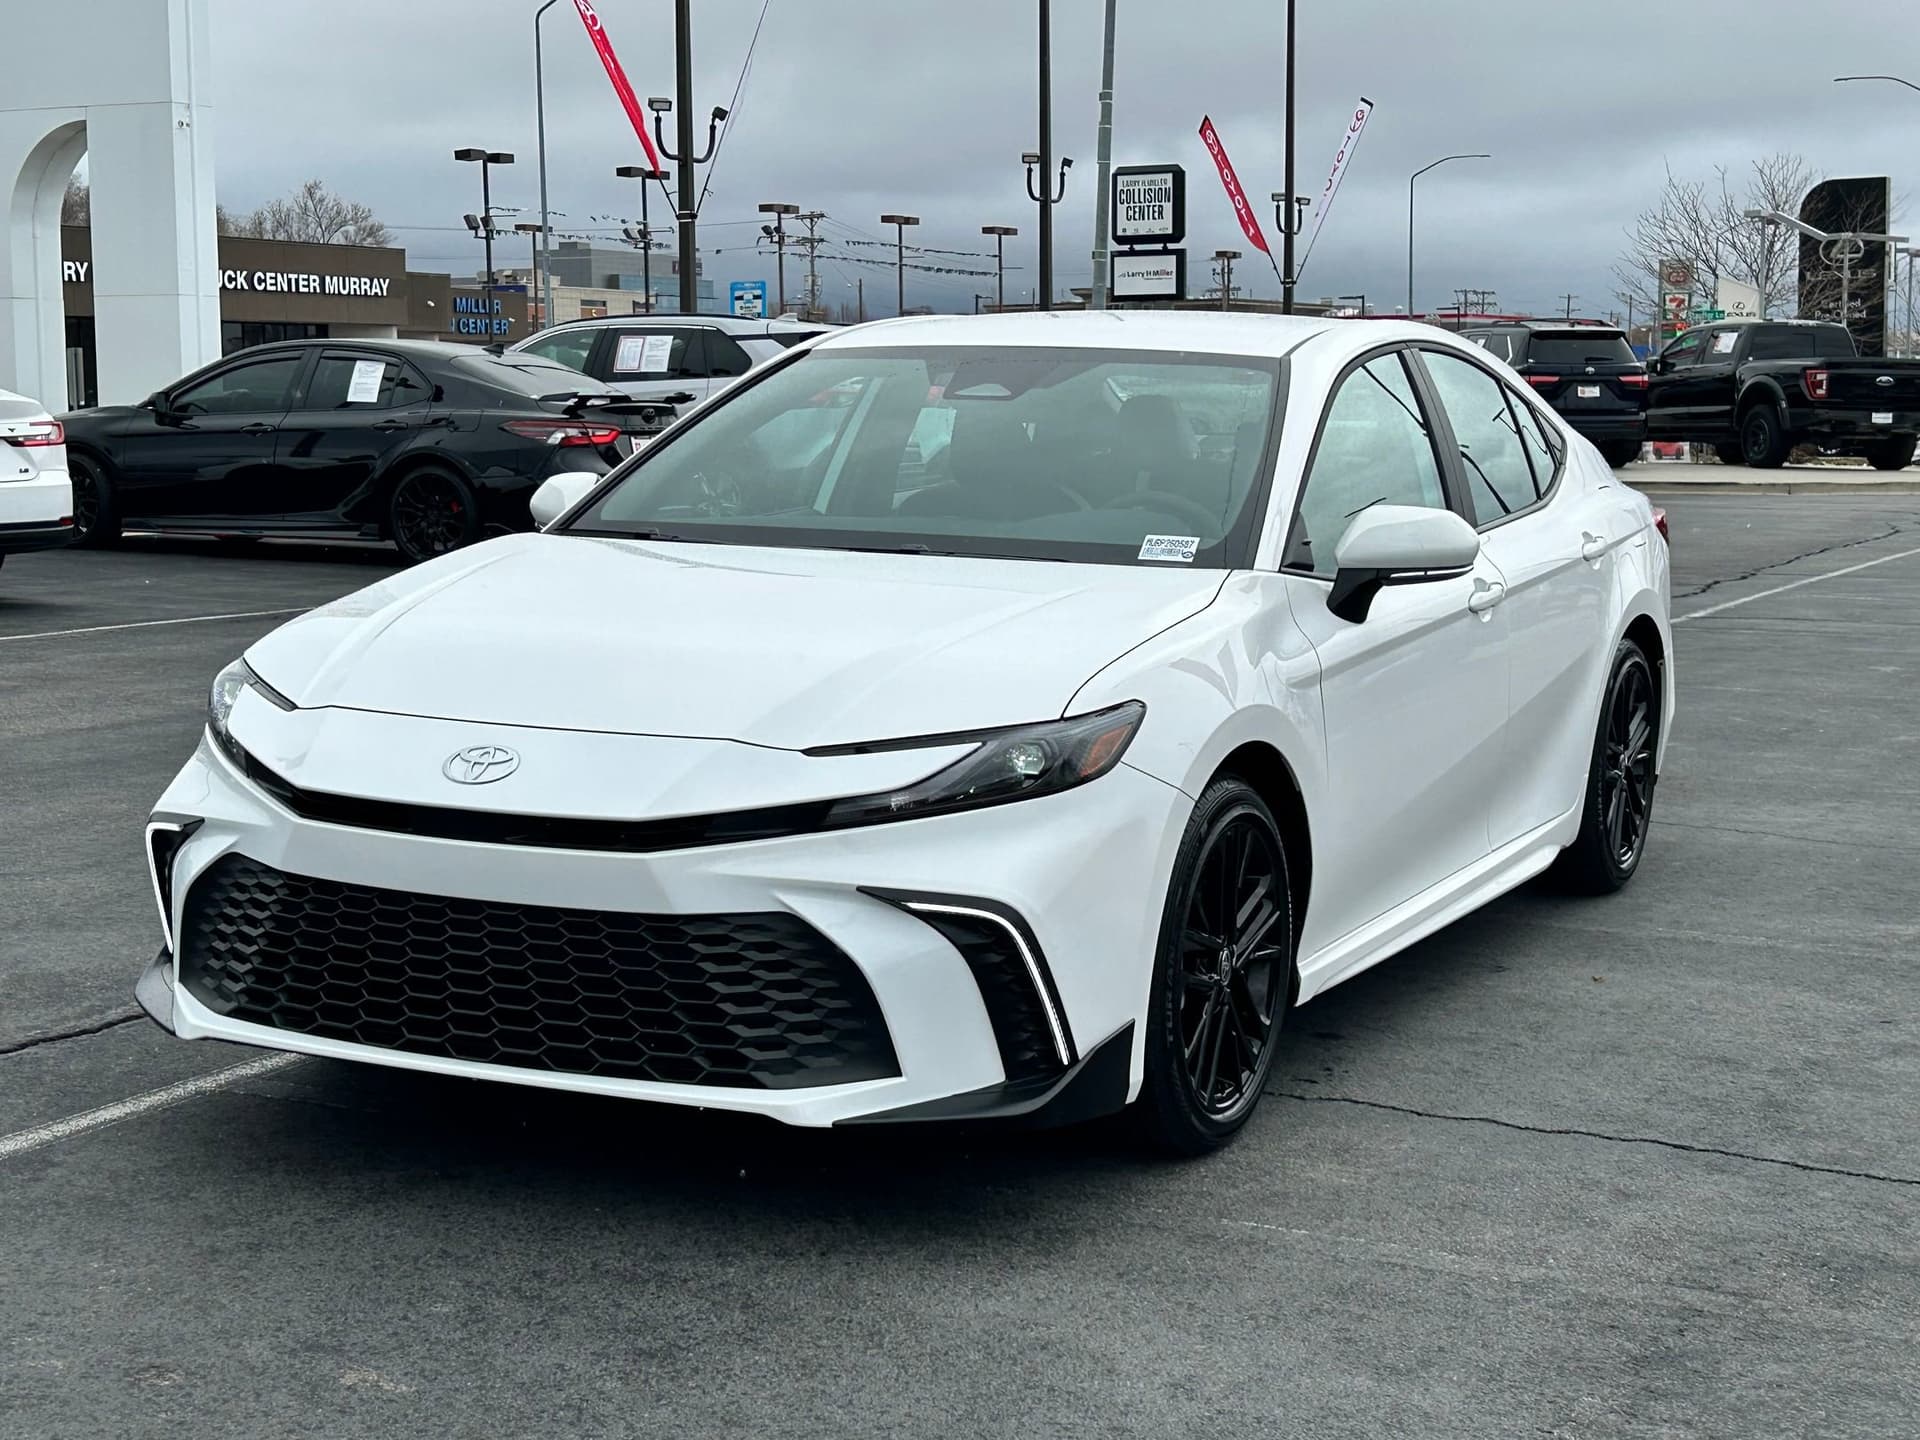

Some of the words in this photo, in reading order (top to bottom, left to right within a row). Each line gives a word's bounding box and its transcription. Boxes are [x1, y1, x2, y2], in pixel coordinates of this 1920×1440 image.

[1119, 186, 1171, 205] COLLISION
[1126, 204, 1164, 221] CENTER
[63, 261, 89, 282] RY
[1152, 269, 1174, 277] Miller
[253, 271, 321, 293] CENTER
[325, 275, 390, 297] MURRAY
